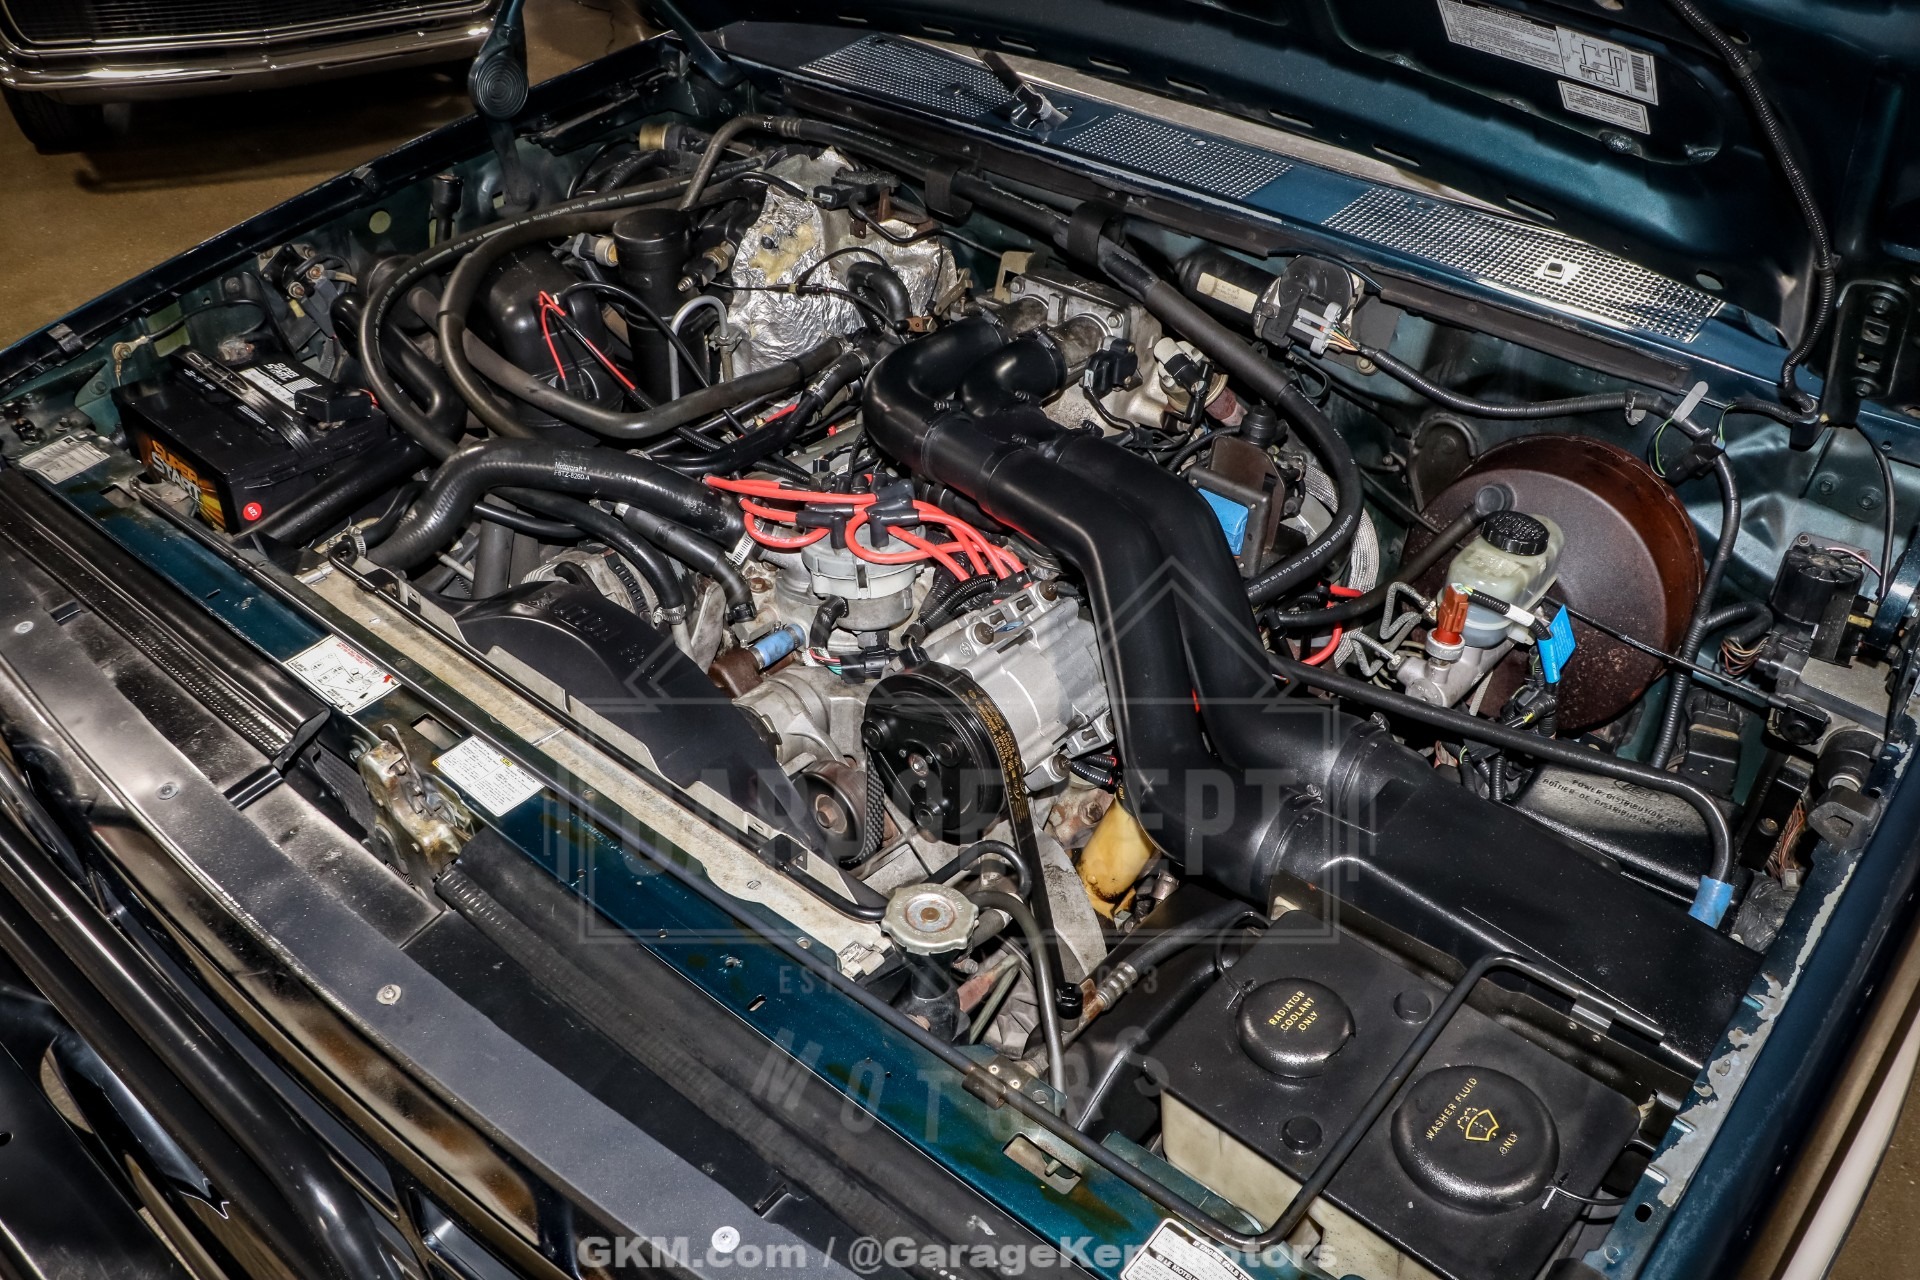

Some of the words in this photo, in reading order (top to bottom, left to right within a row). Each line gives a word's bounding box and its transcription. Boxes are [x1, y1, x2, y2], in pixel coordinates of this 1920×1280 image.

[151, 439, 199, 484] SUPER
[151, 451, 201, 500] START
[1268, 990, 1306, 1026] RADIATOR
[1280, 997, 1315, 1031] COOLANT
[1298, 1010, 1318, 1031] ONLY
[1425, 1103, 1457, 1141] WASHER
[1455, 1077, 1478, 1103] FLUID
[1499, 1132, 1518, 1155] ONLY
[1199, 1244, 1224, 1263] ENGINE
[1222, 1258, 1240, 1277] FAILS
